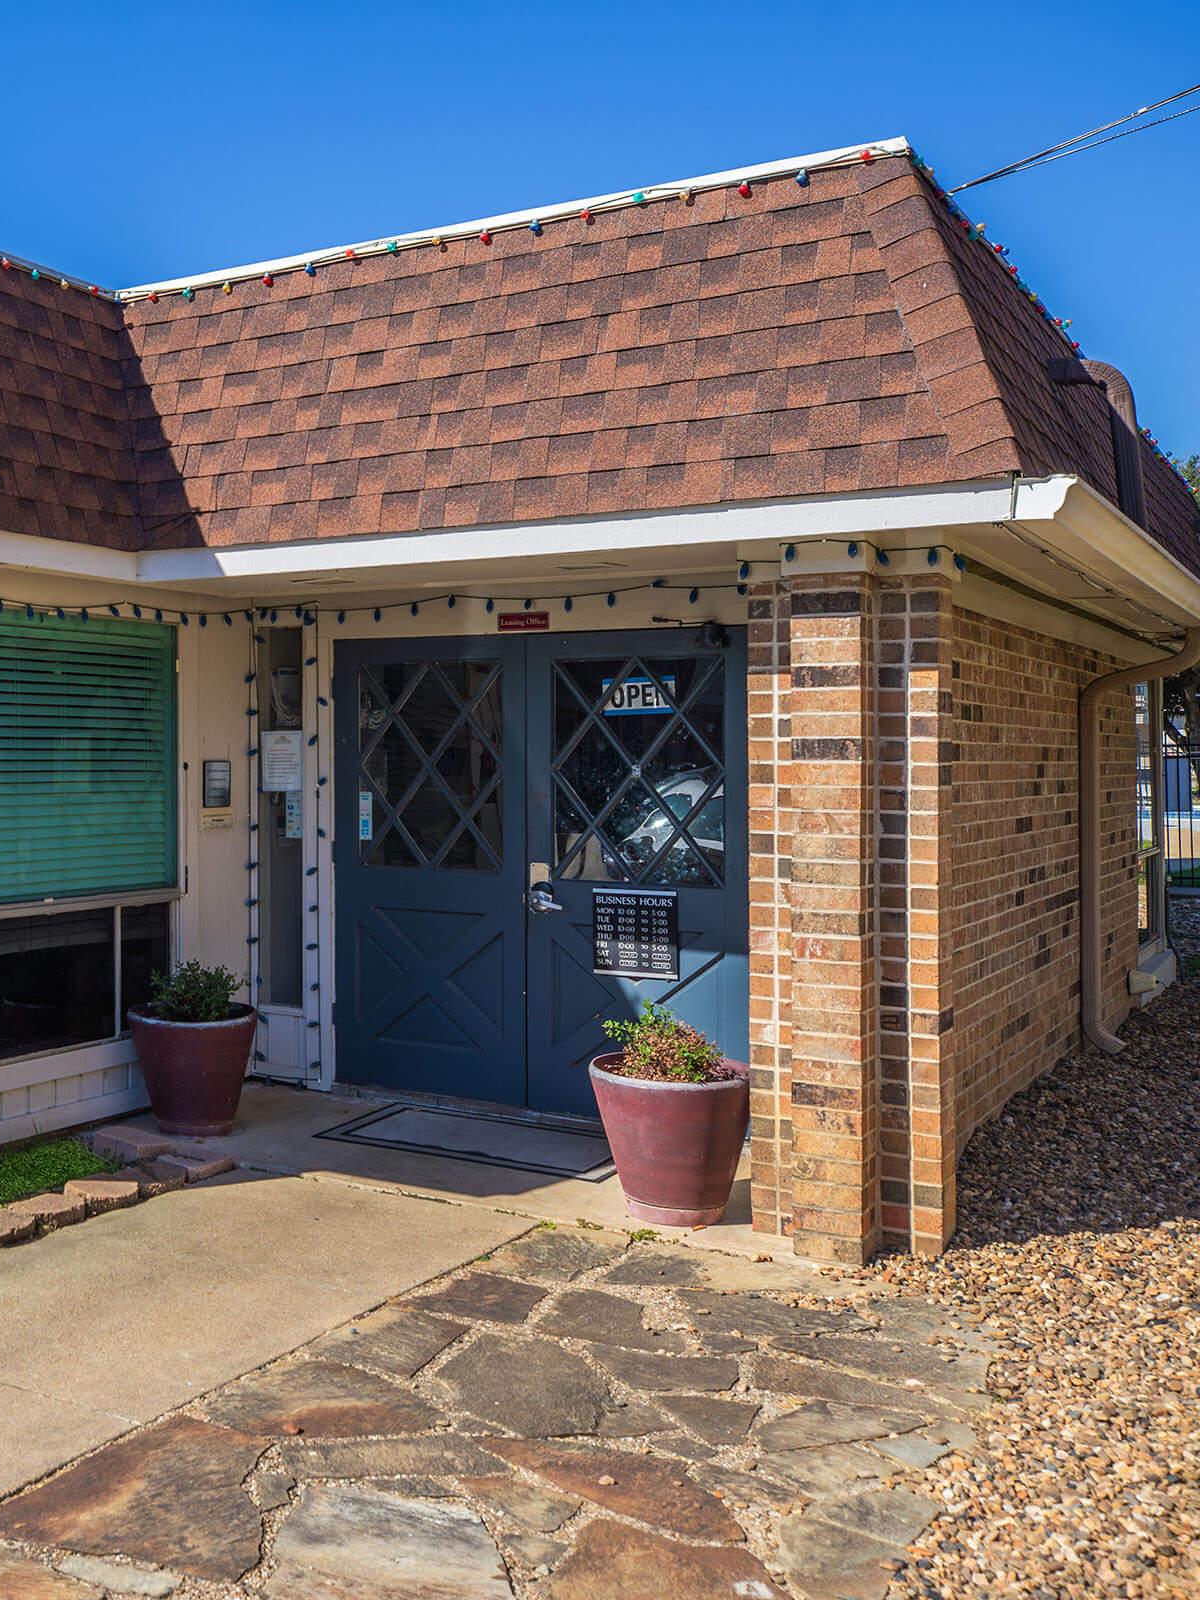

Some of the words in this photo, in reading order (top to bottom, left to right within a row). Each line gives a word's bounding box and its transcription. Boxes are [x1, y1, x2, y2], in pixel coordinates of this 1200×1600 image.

[500, 617, 525, 626] Leasing
[527, 616, 545, 625] Office
[595, 895, 636, 906] BUSINESS
[639, 897, 673, 907] HOURS
[595, 907, 615, 915] MON
[597, 915, 610, 923] TUE
[597, 932, 612, 940] THU
[597, 958, 612, 966] SUN
